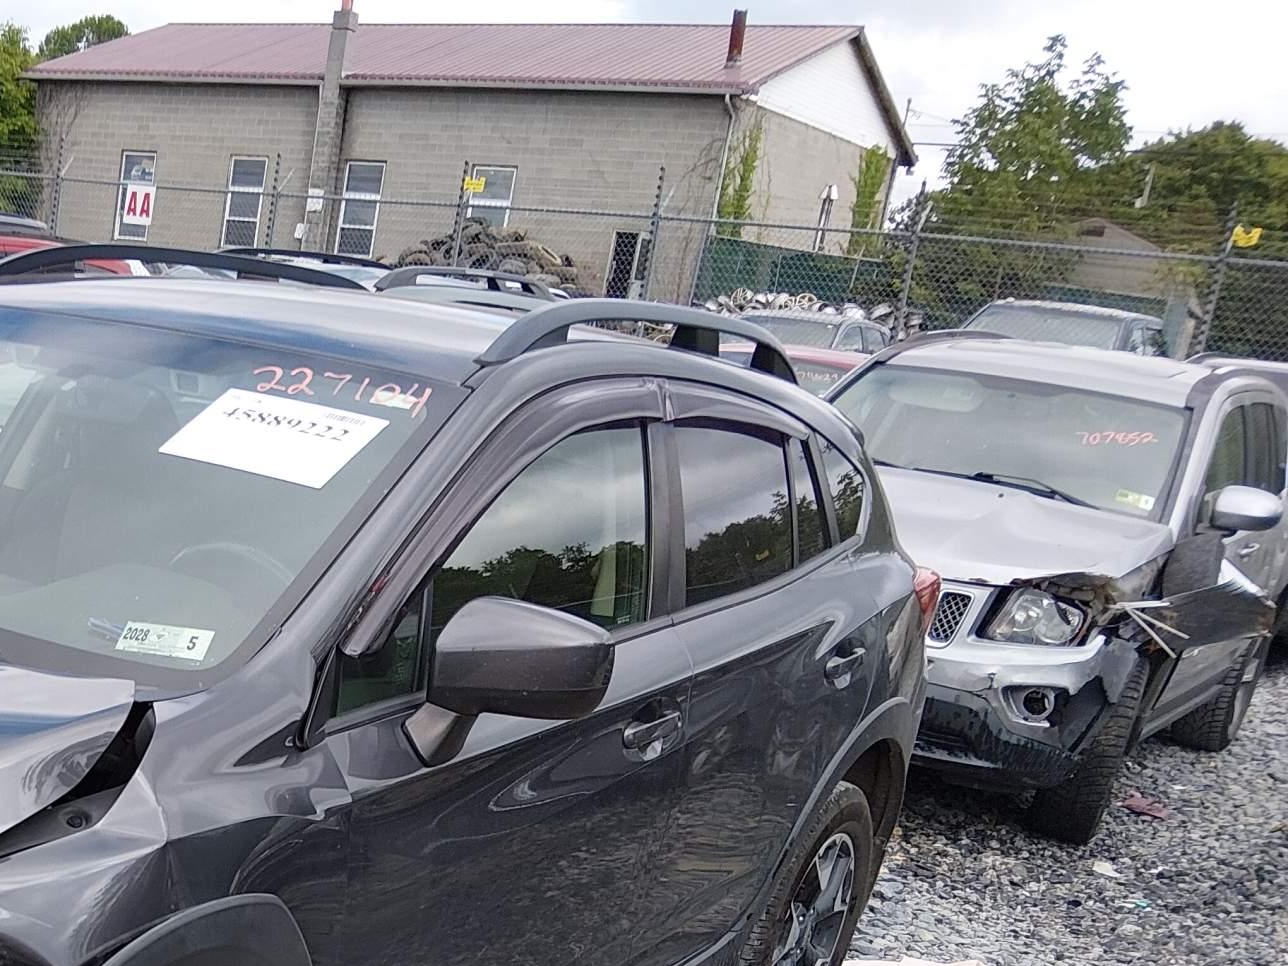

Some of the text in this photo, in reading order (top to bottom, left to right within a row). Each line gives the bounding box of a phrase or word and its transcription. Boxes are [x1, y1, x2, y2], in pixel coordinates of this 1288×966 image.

[126, 191, 151, 218] AA
[253, 366, 433, 418] 227104
[222, 407, 350, 442] 45889222
[122, 626, 200, 651] 2028 5
